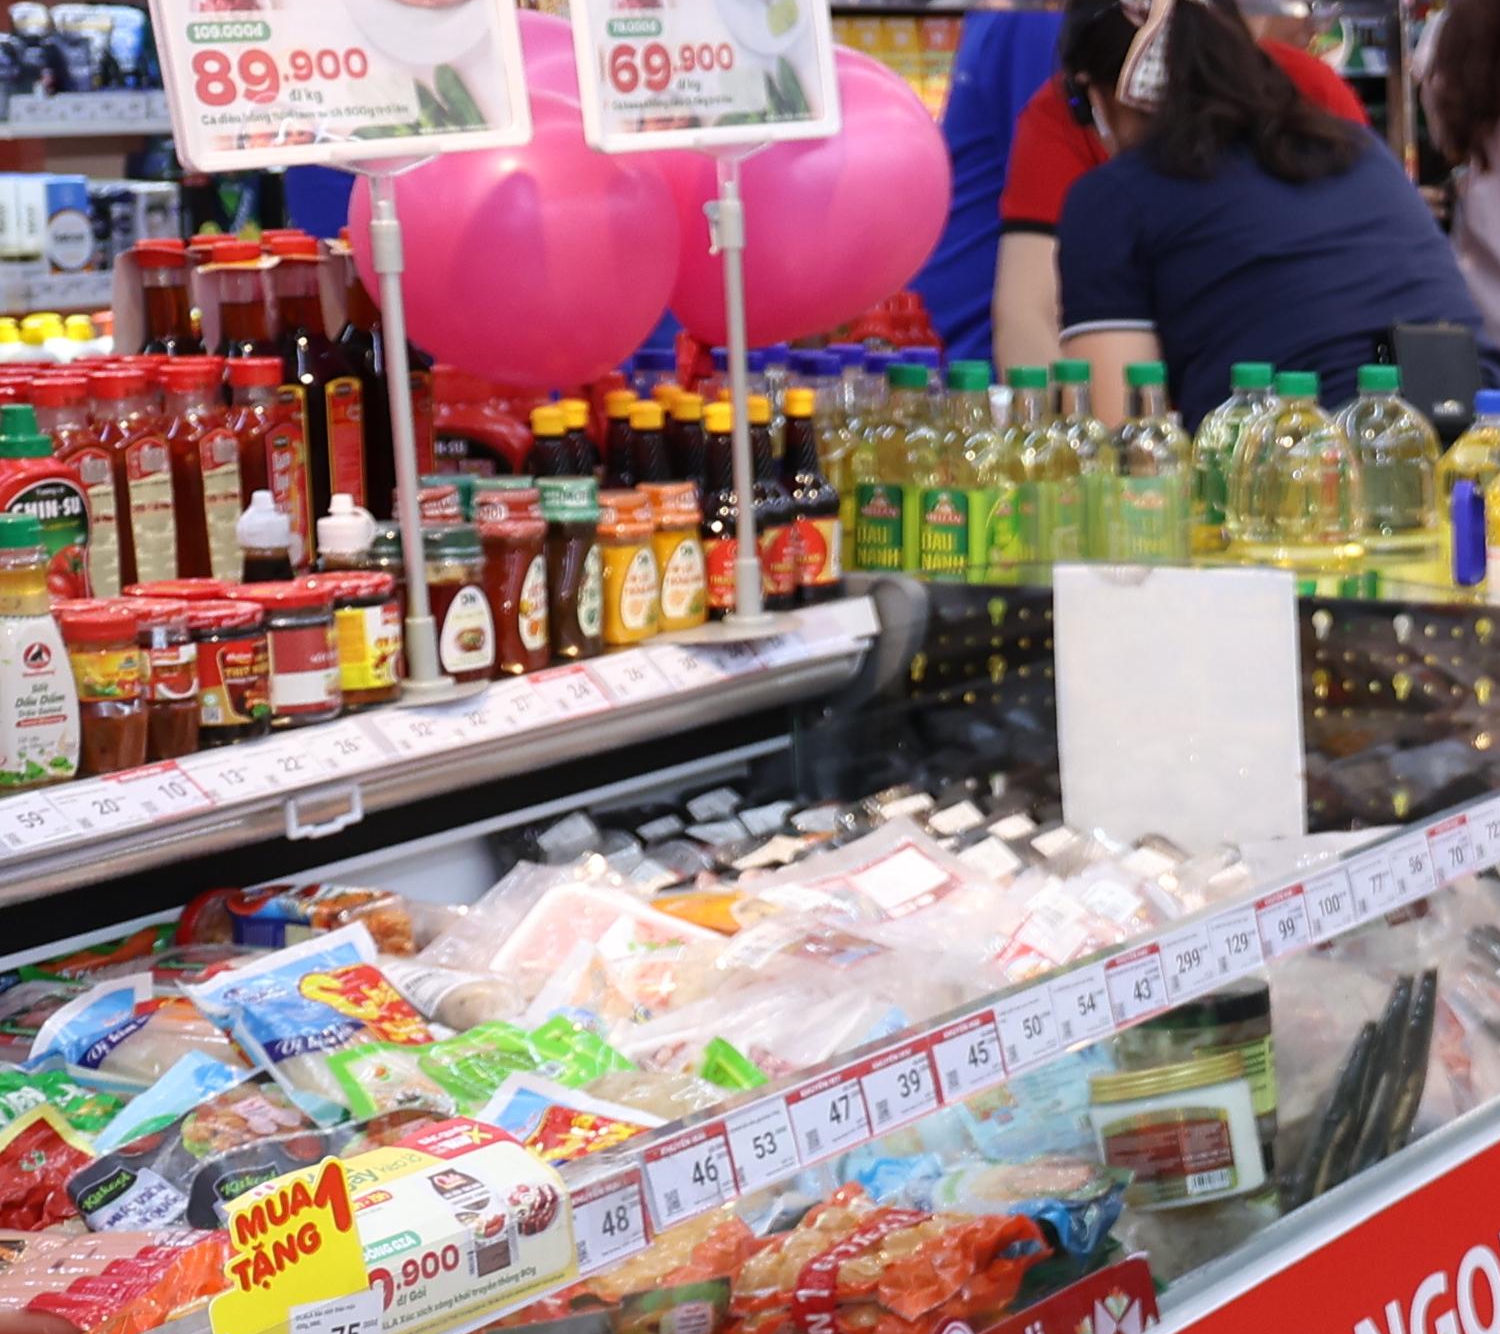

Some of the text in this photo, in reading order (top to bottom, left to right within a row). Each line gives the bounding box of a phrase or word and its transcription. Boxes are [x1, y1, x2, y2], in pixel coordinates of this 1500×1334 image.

[190, 45, 369, 107] 89.900
[609, 42, 734, 94] 69.900
[218, 767, 246, 788] 13
[277, 754, 302, 774] 22
[158, 779, 187, 802] 10
[93, 796, 120, 817] 20
[1447, 844, 1465, 868] 70
[1317, 893, 1341, 918] 100
[1278, 915, 1297, 941] 99
[1224, 931, 1249, 956] 129
[1132, 977, 1152, 1002] 43
[1077, 991, 1098, 1017] 54
[1022, 1014, 1043, 1041] 50
[967, 1040, 991, 1069] 45
[896, 1067, 922, 1099] 39
[828, 1093, 851, 1127] 47
[752, 1131, 778, 1161] 53
[691, 1155, 719, 1188] 46
[234, 1179, 313, 1247] MUA
[313, 1160, 353, 1234] 1
[601, 1205, 630, 1238] 48
[230, 1220, 323, 1292] TẶNG
